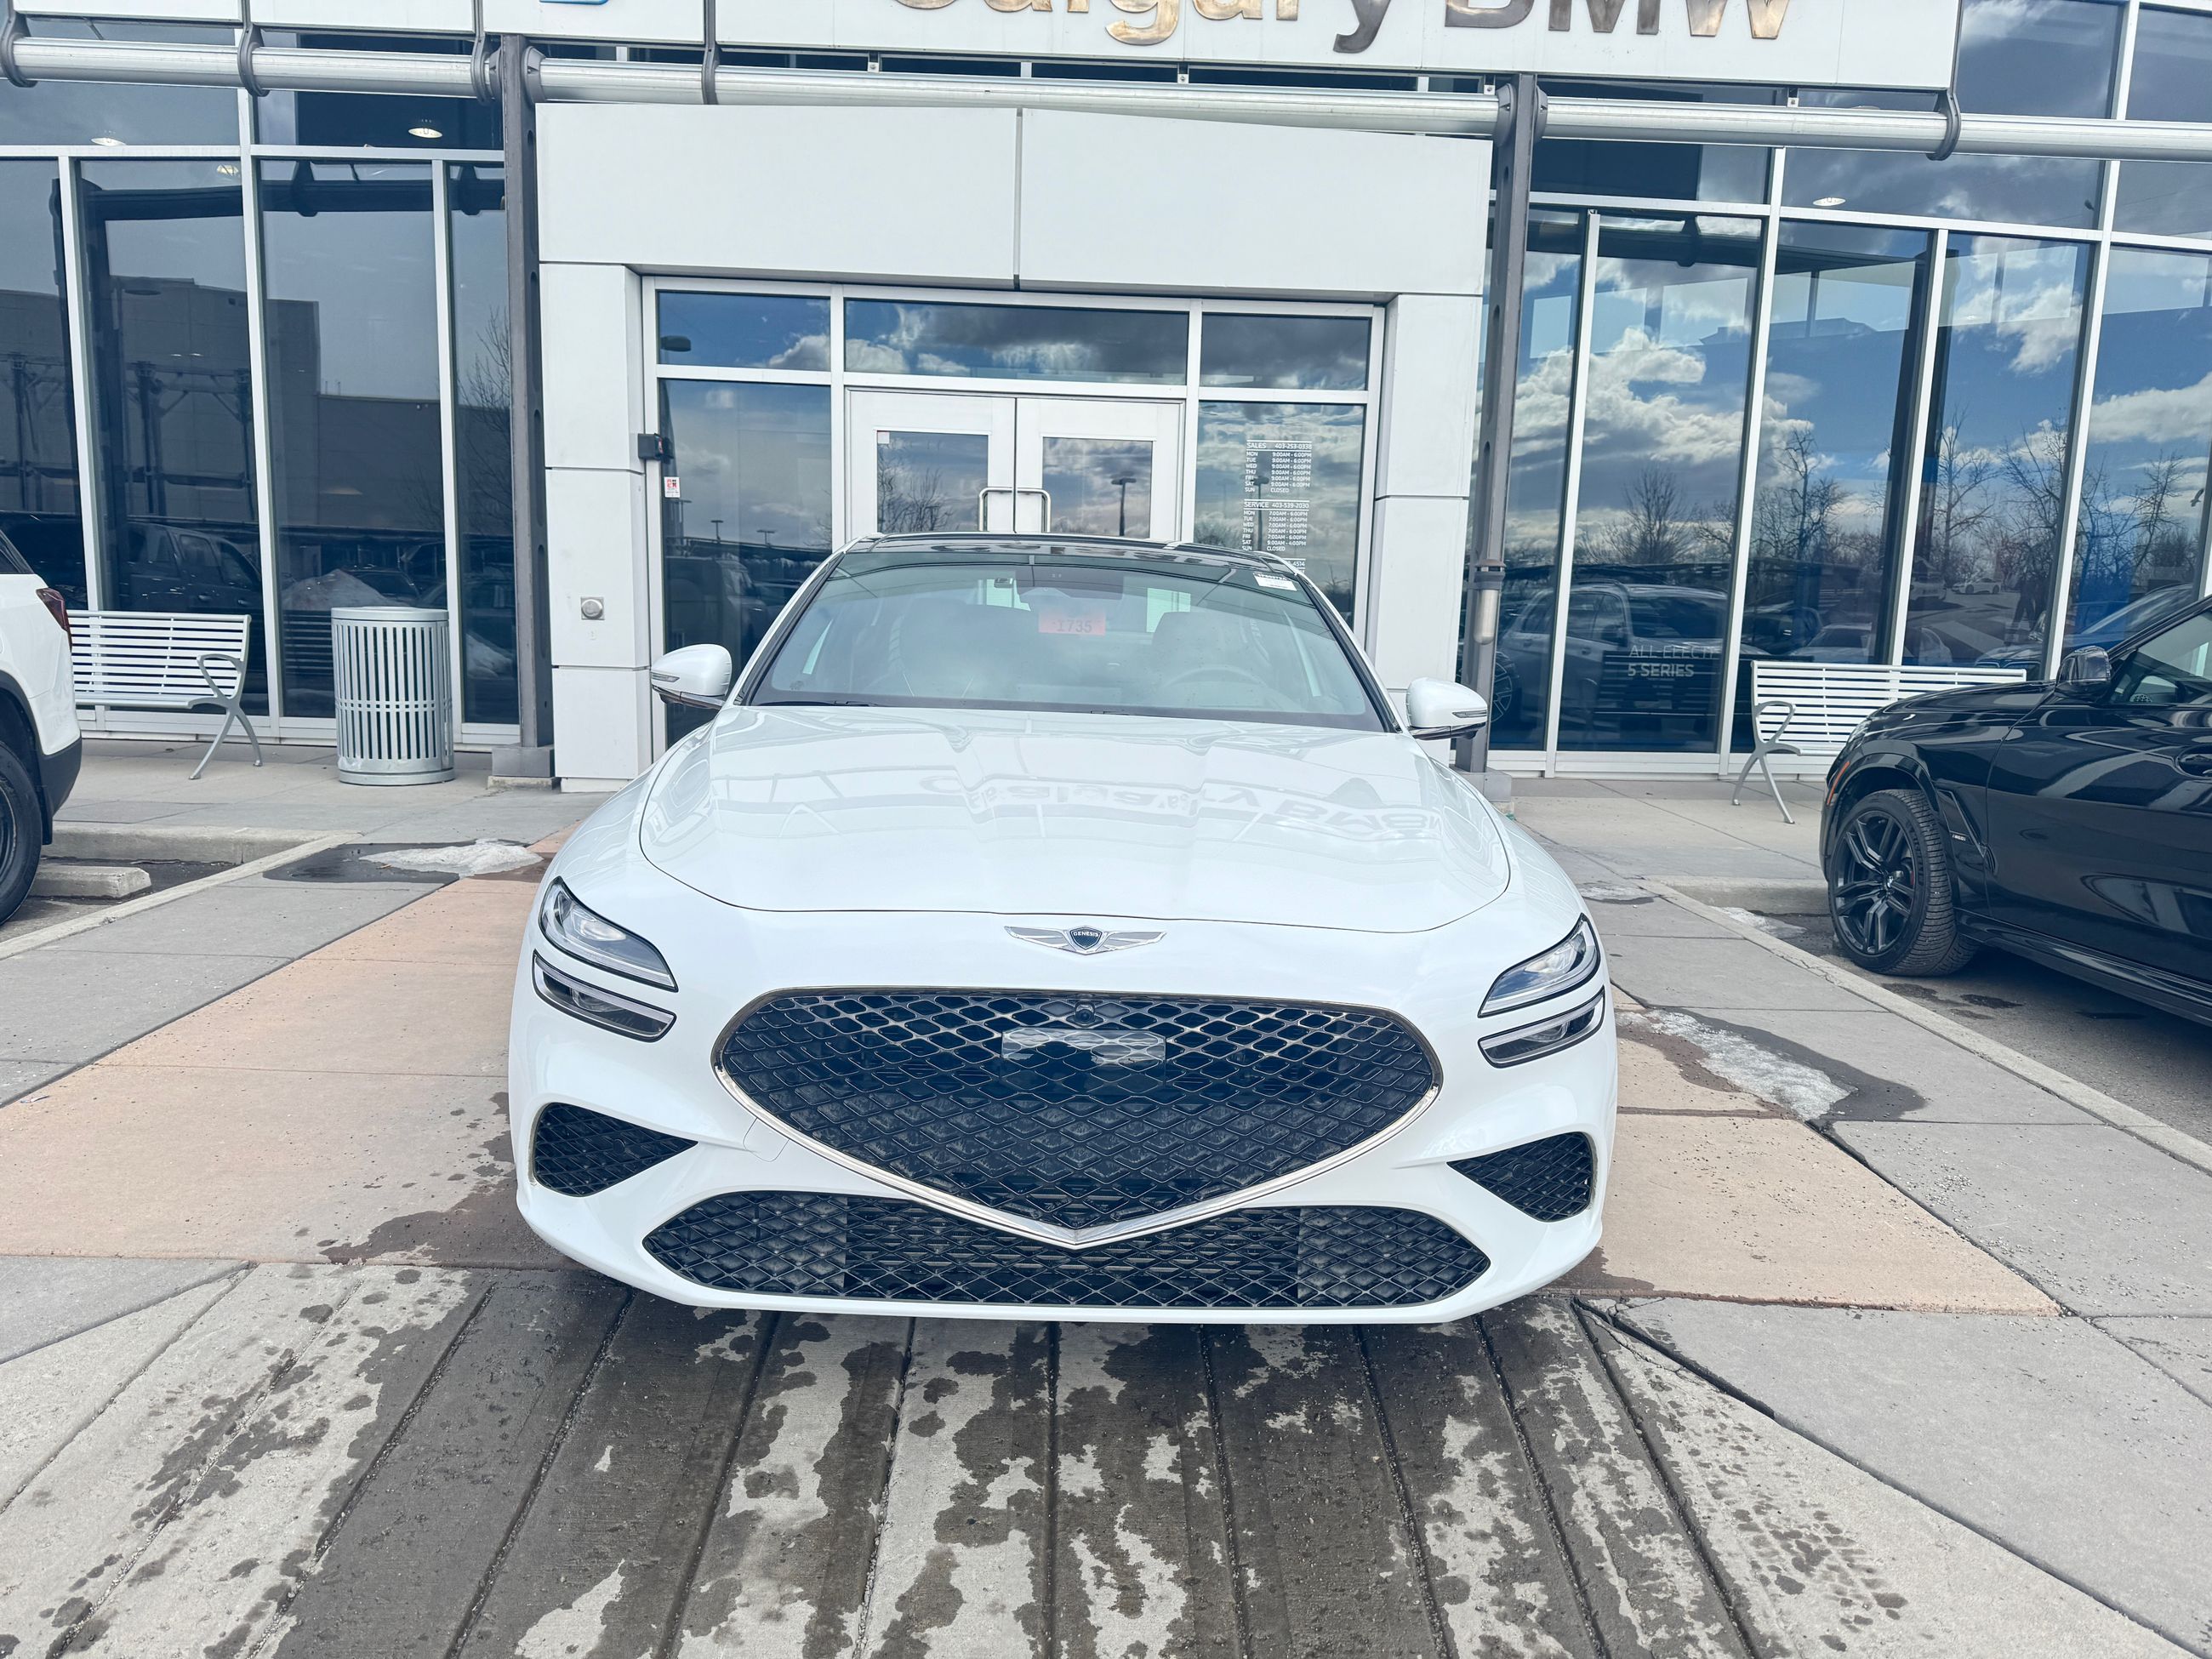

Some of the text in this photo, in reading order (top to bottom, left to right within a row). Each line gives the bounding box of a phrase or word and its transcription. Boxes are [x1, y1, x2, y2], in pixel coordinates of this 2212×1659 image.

[1057, 619, 1092, 633] 1735
[1628, 664, 1694, 677] 5 SERIES
